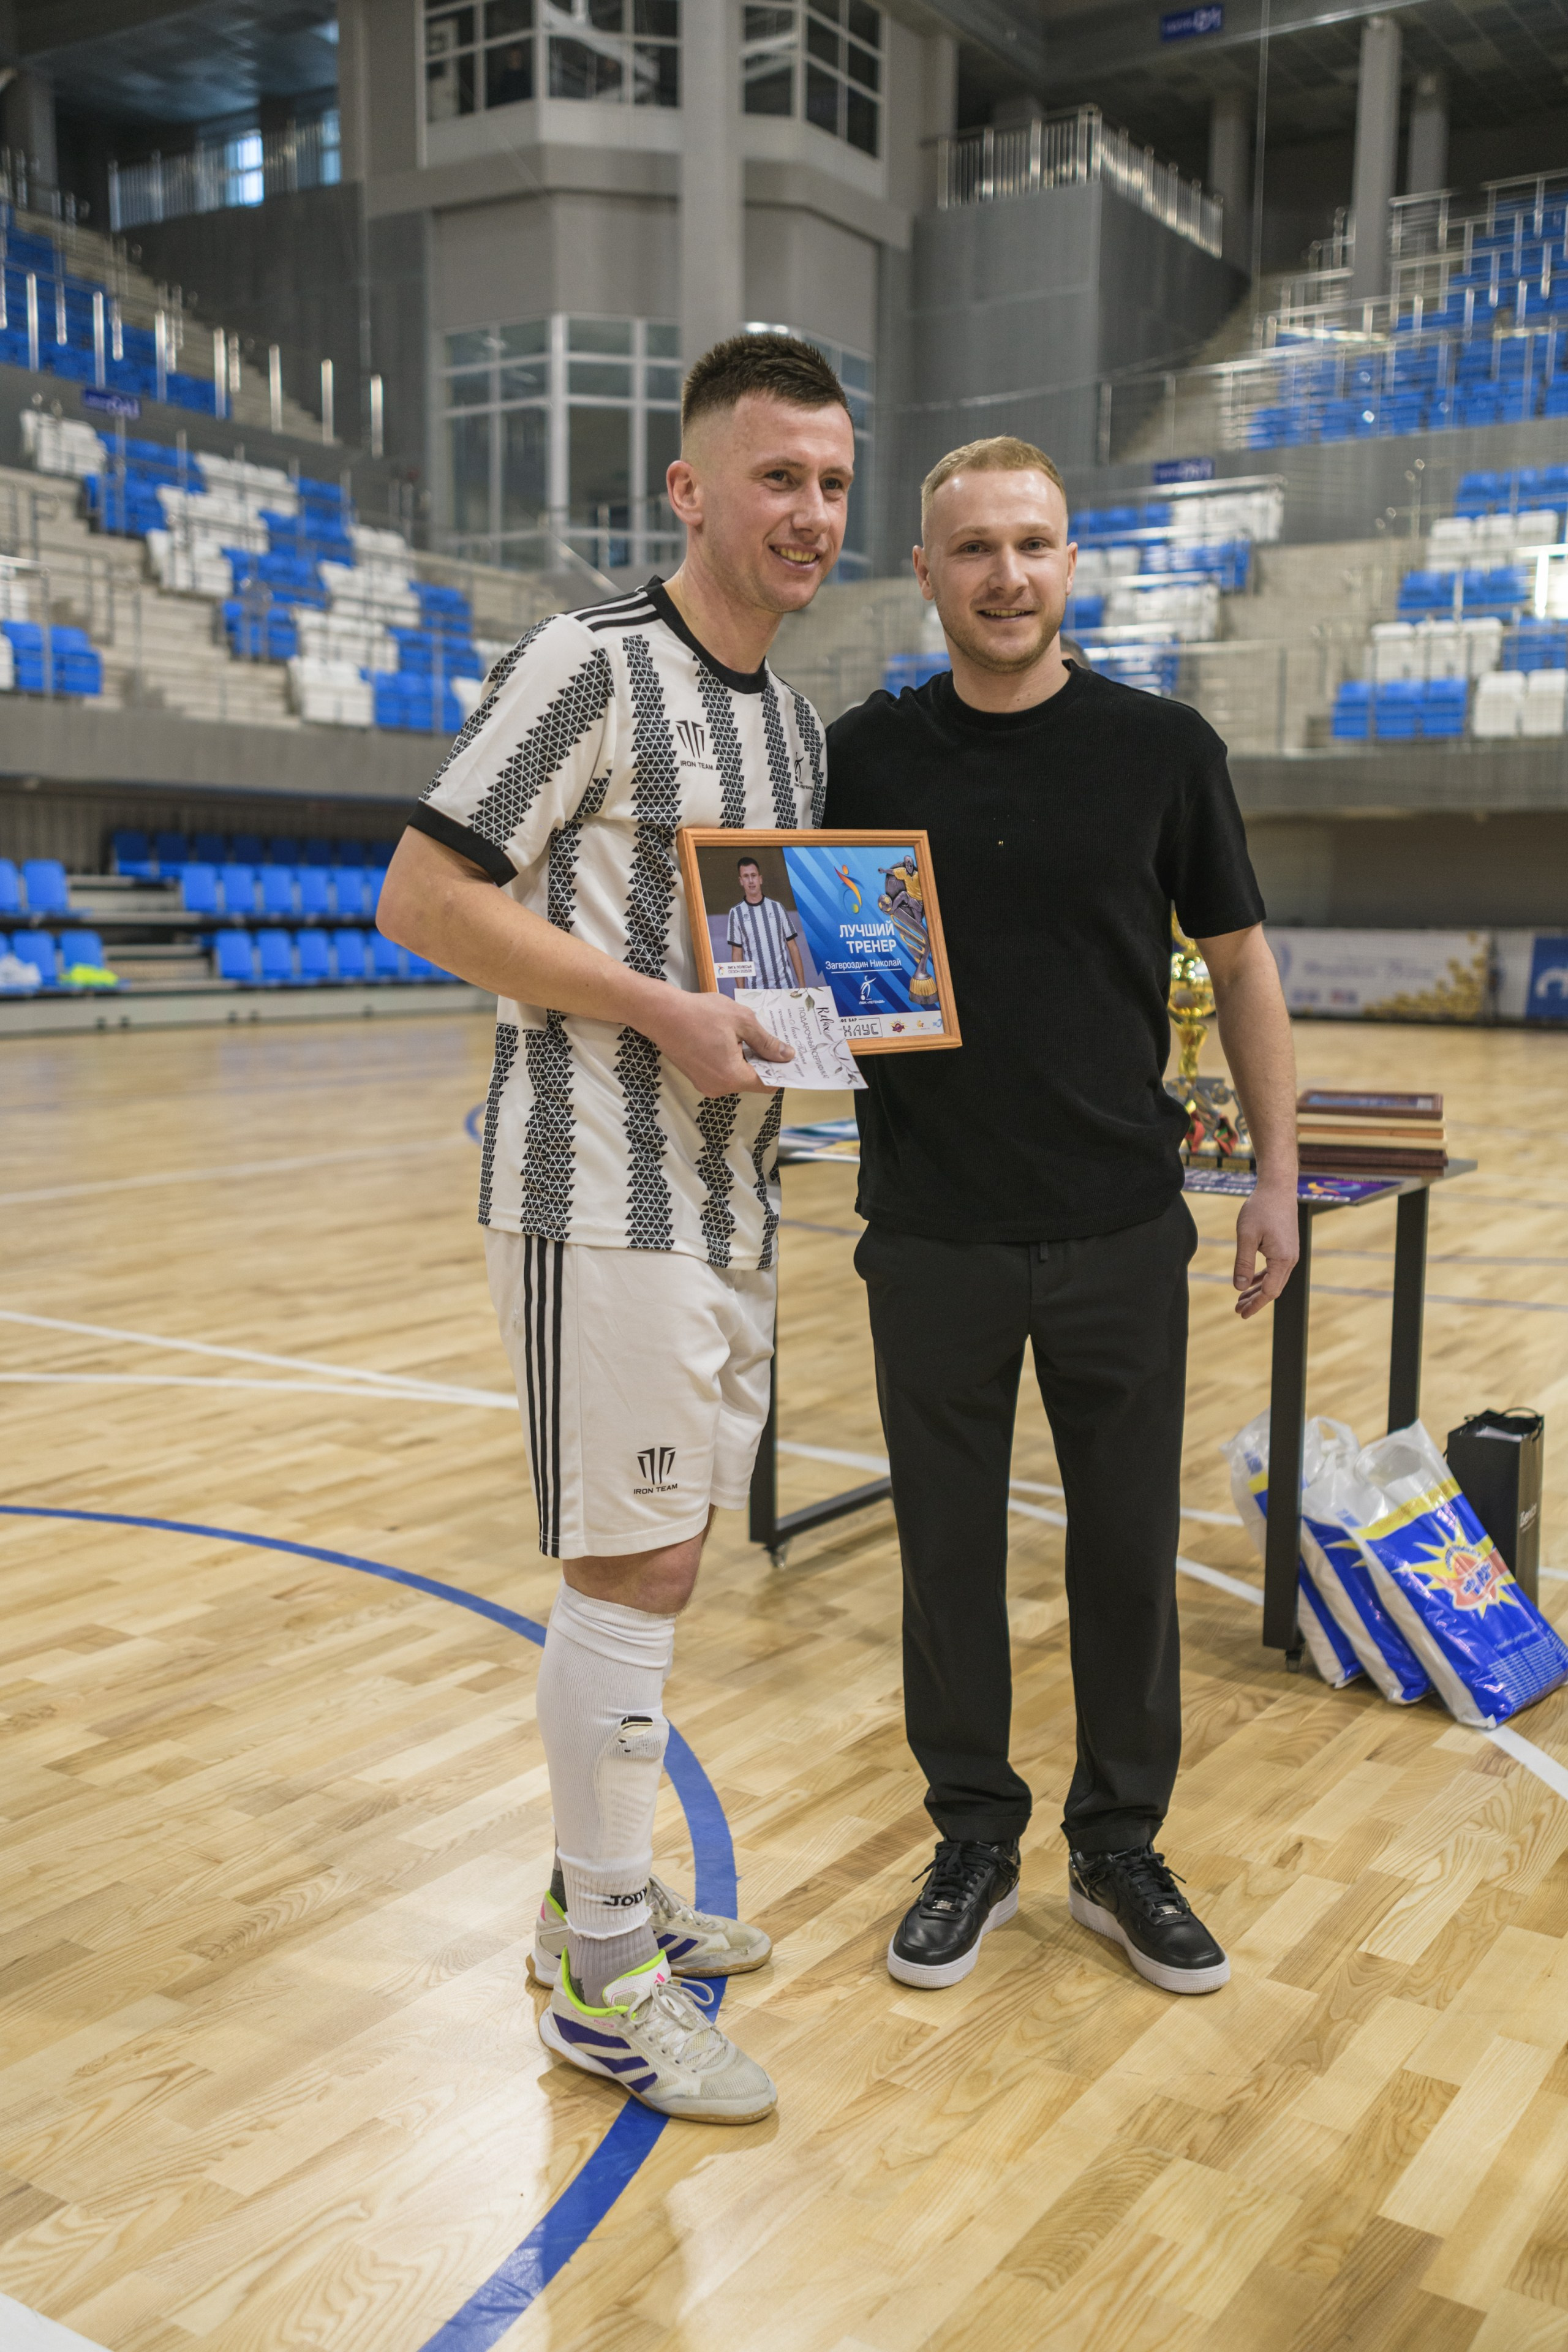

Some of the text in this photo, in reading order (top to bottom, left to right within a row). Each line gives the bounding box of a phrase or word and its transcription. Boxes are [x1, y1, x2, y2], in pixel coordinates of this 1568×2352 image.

[698, 762, 714, 771] TEAM
[840, 920, 895, 938] ЛУЧШИЙ
[846, 939, 897, 954] ТРЕНЕР
[825, 958, 902, 971] Загвроздин Николай
[816, 1007, 835, 1032] Relax
[655, 1483, 678, 1493] TEAM
